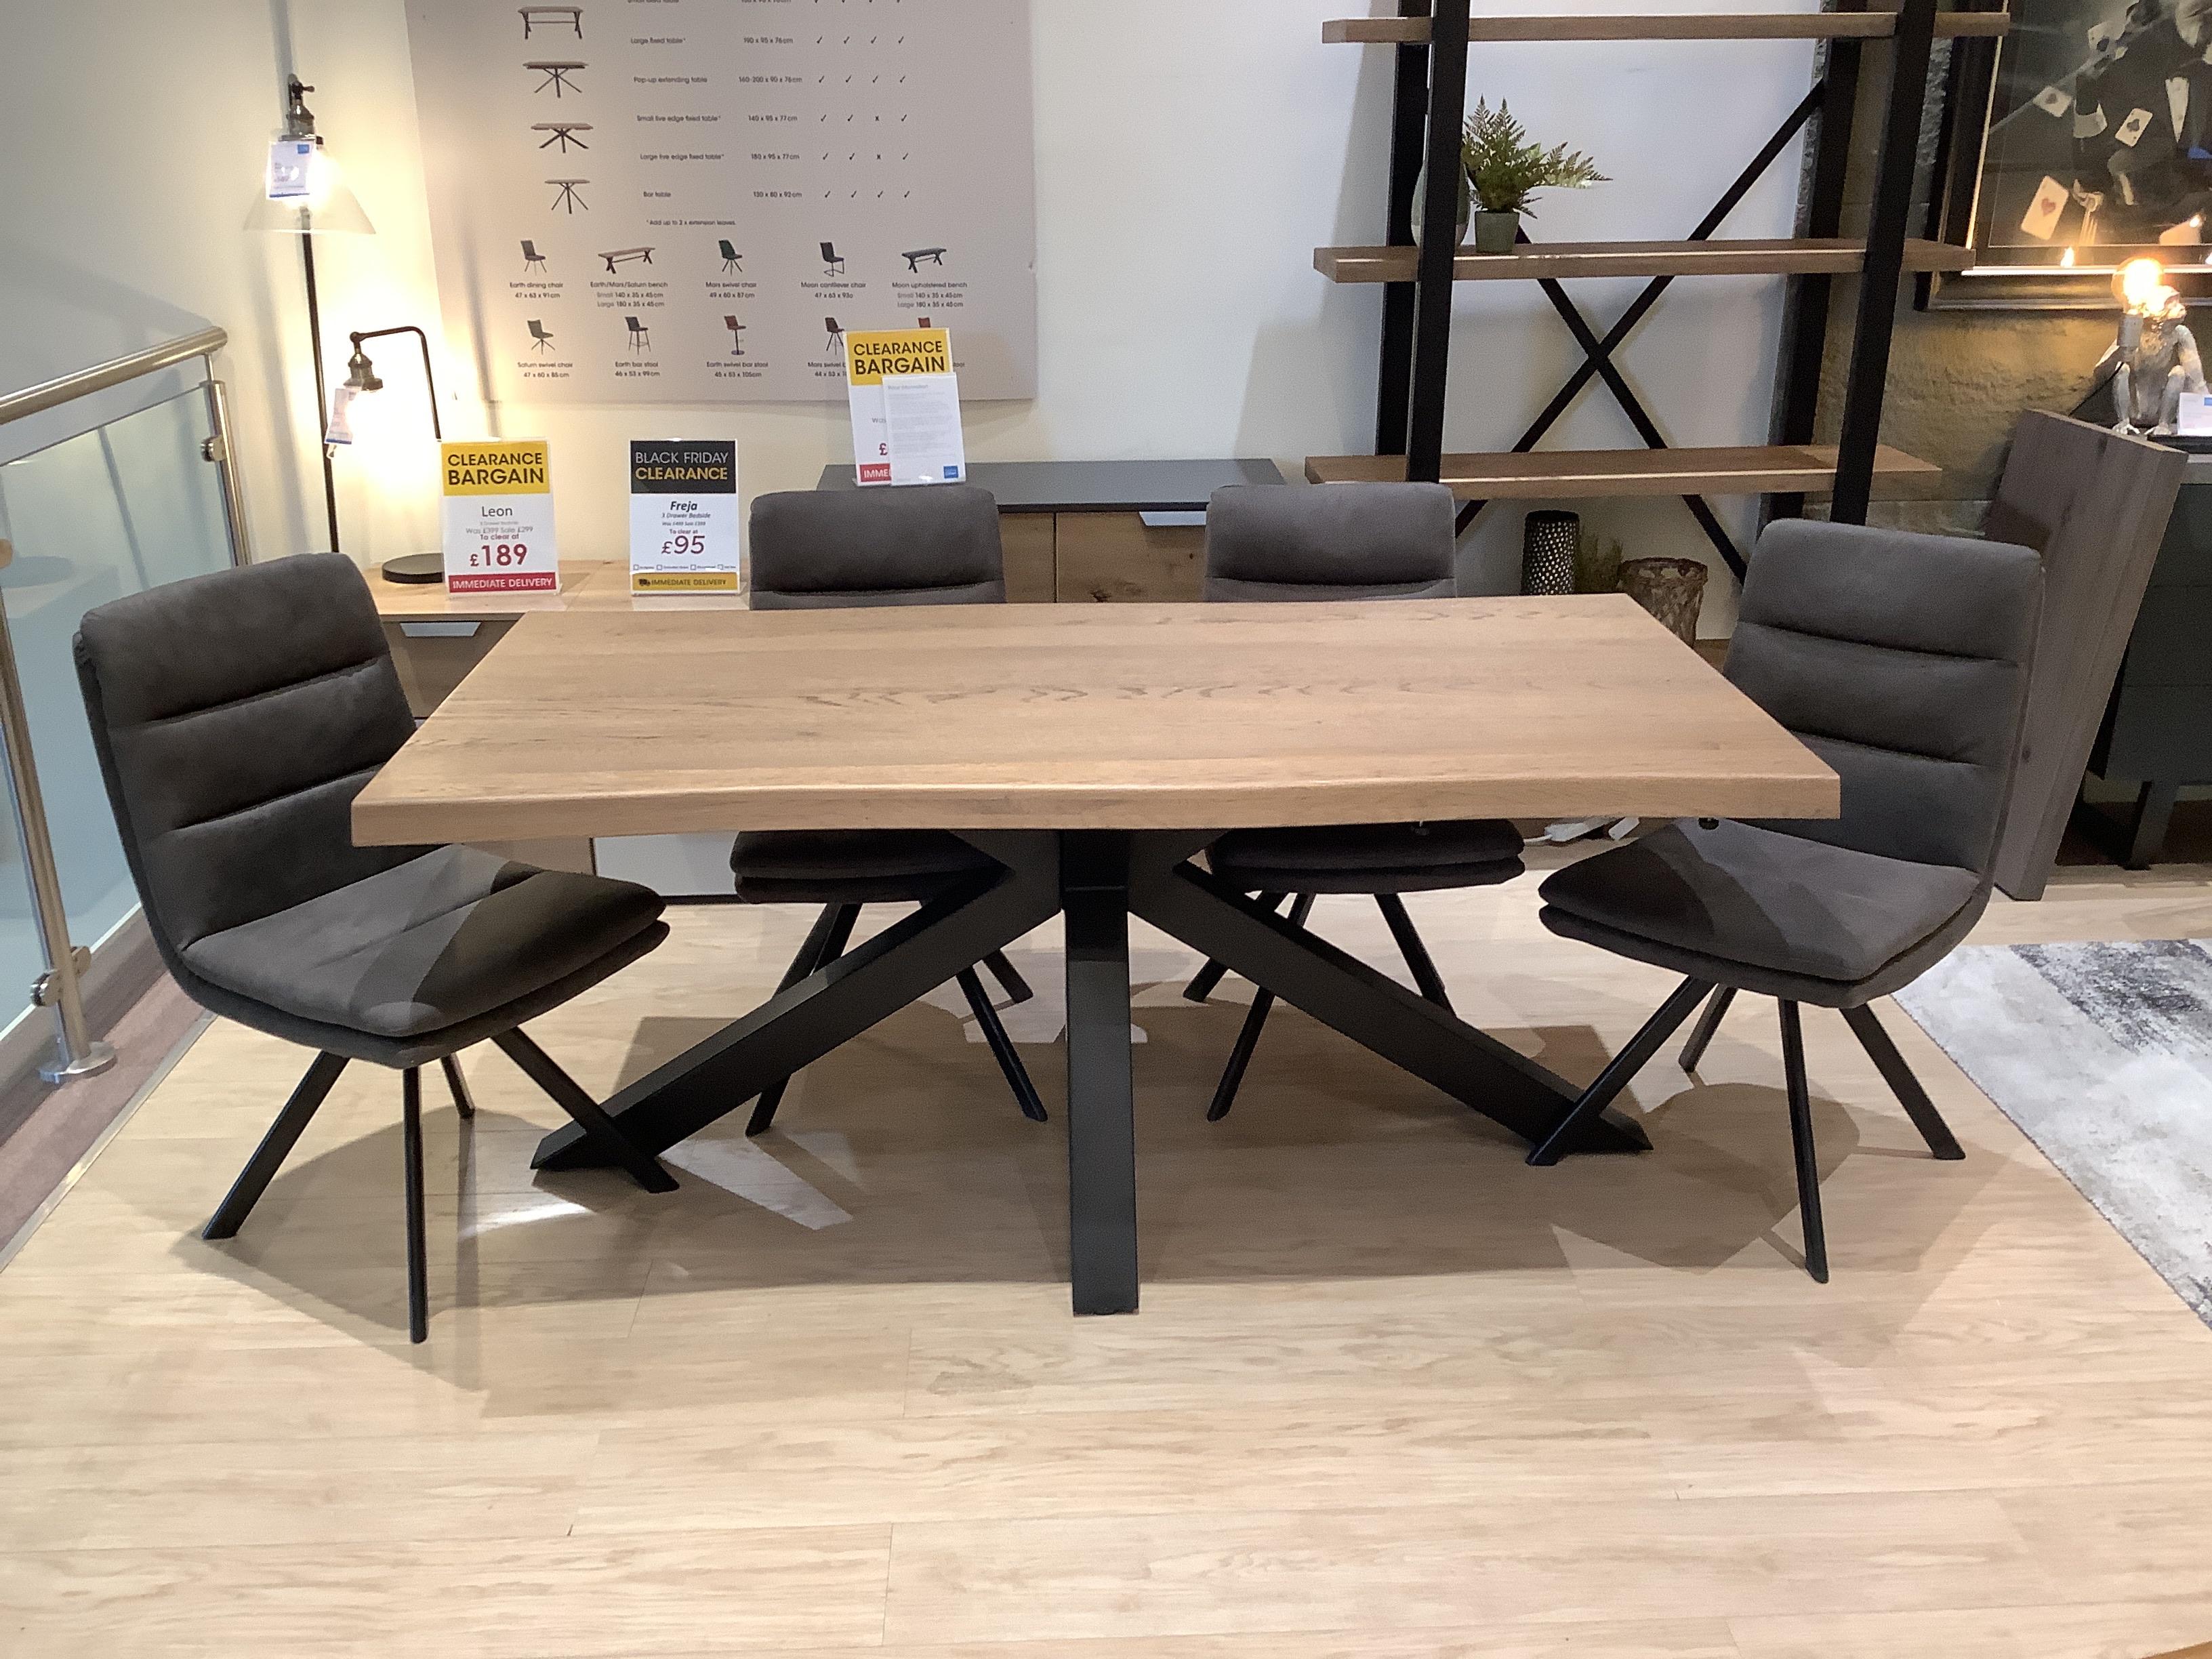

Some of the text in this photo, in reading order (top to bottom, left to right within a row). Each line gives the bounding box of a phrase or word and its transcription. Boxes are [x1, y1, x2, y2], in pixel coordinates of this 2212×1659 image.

[854, 341, 943, 356] CLEARANCE
[855, 356, 945, 375] BARGAIN
[448, 453, 542, 466] CLEARANCE
[636, 452, 729, 464] BLACK FRIDAY
[448, 468, 544, 485] BARGAIN
[635, 467, 728, 480] CLEARANCE
[481, 506, 513, 517] Leon
[670, 501, 698, 512] Freja
[661, 535, 705, 554] £95
[470, 544, 528, 567] £189
[453, 577, 552, 589] IMMEDIATE DELIVERY
